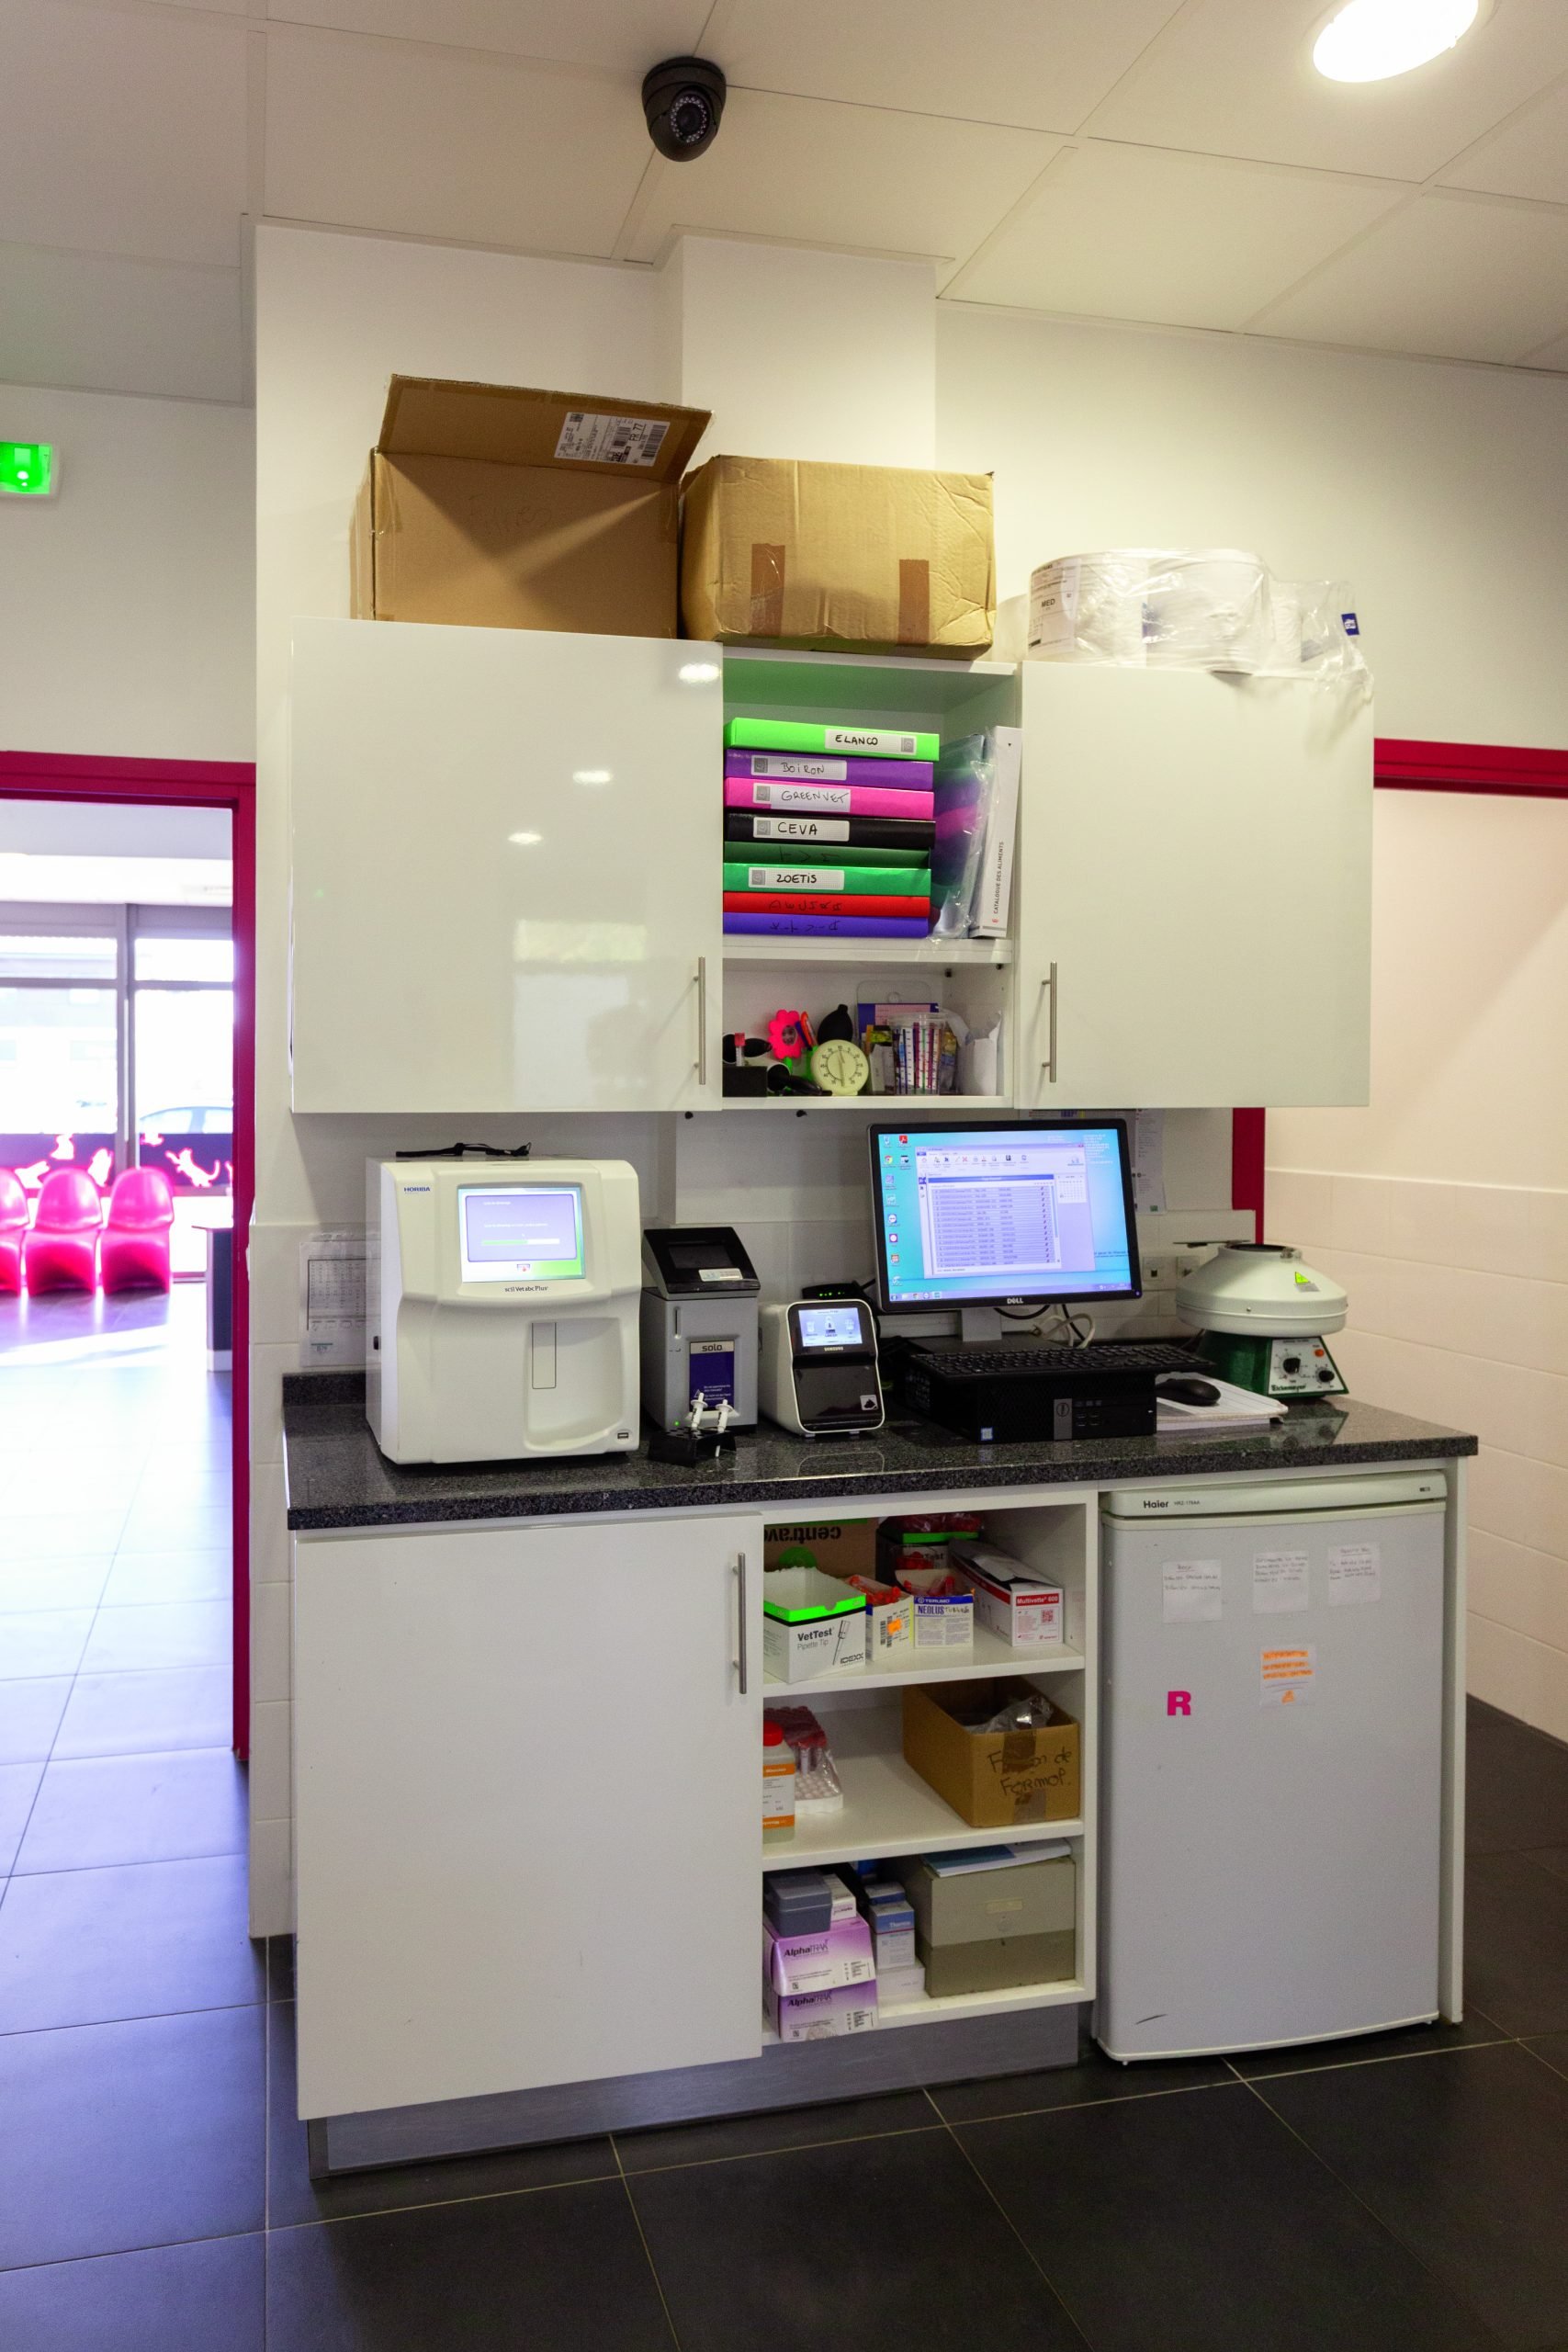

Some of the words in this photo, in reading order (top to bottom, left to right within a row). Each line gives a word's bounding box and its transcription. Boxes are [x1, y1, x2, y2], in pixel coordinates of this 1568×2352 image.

[835, 734, 878, 745] ELANCO
[781, 790, 850, 804] GREENVET
[777, 821, 818, 835] CEVA
[1007, 1296, 1024, 1305] DELL
[702, 1342, 723, 1352] solo
[1143, 1499, 1169, 1509] Haier
[918, 1605, 944, 1614] NEOLUS
[840, 1653, 864, 1665] IDEXX
[1168, 1691, 1191, 1716] R
